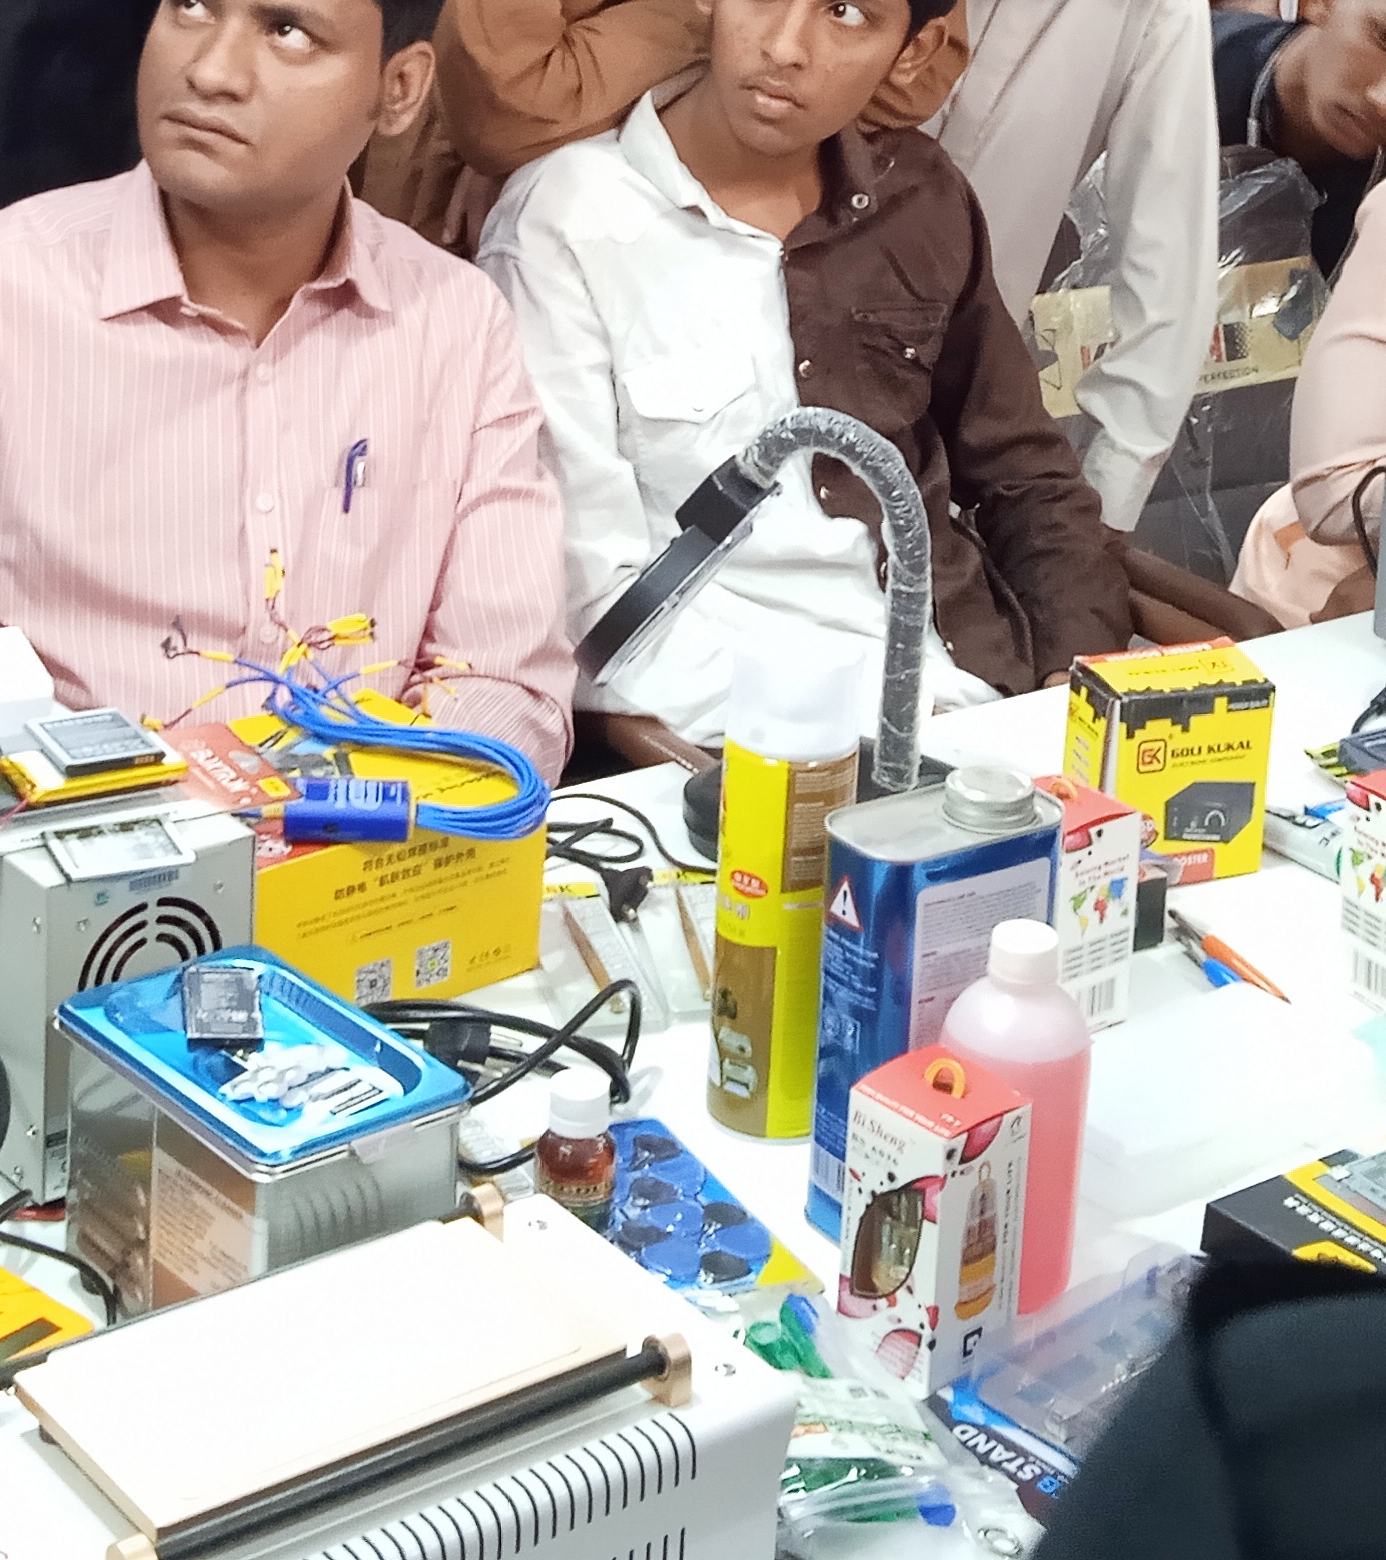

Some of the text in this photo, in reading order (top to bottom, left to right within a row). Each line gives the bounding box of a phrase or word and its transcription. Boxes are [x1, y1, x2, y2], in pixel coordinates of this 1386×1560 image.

[1206, 739, 1253, 755] KUKAL
[869, 1120, 907, 1155] Sheng
[953, 1423, 1042, 1480] STAND
